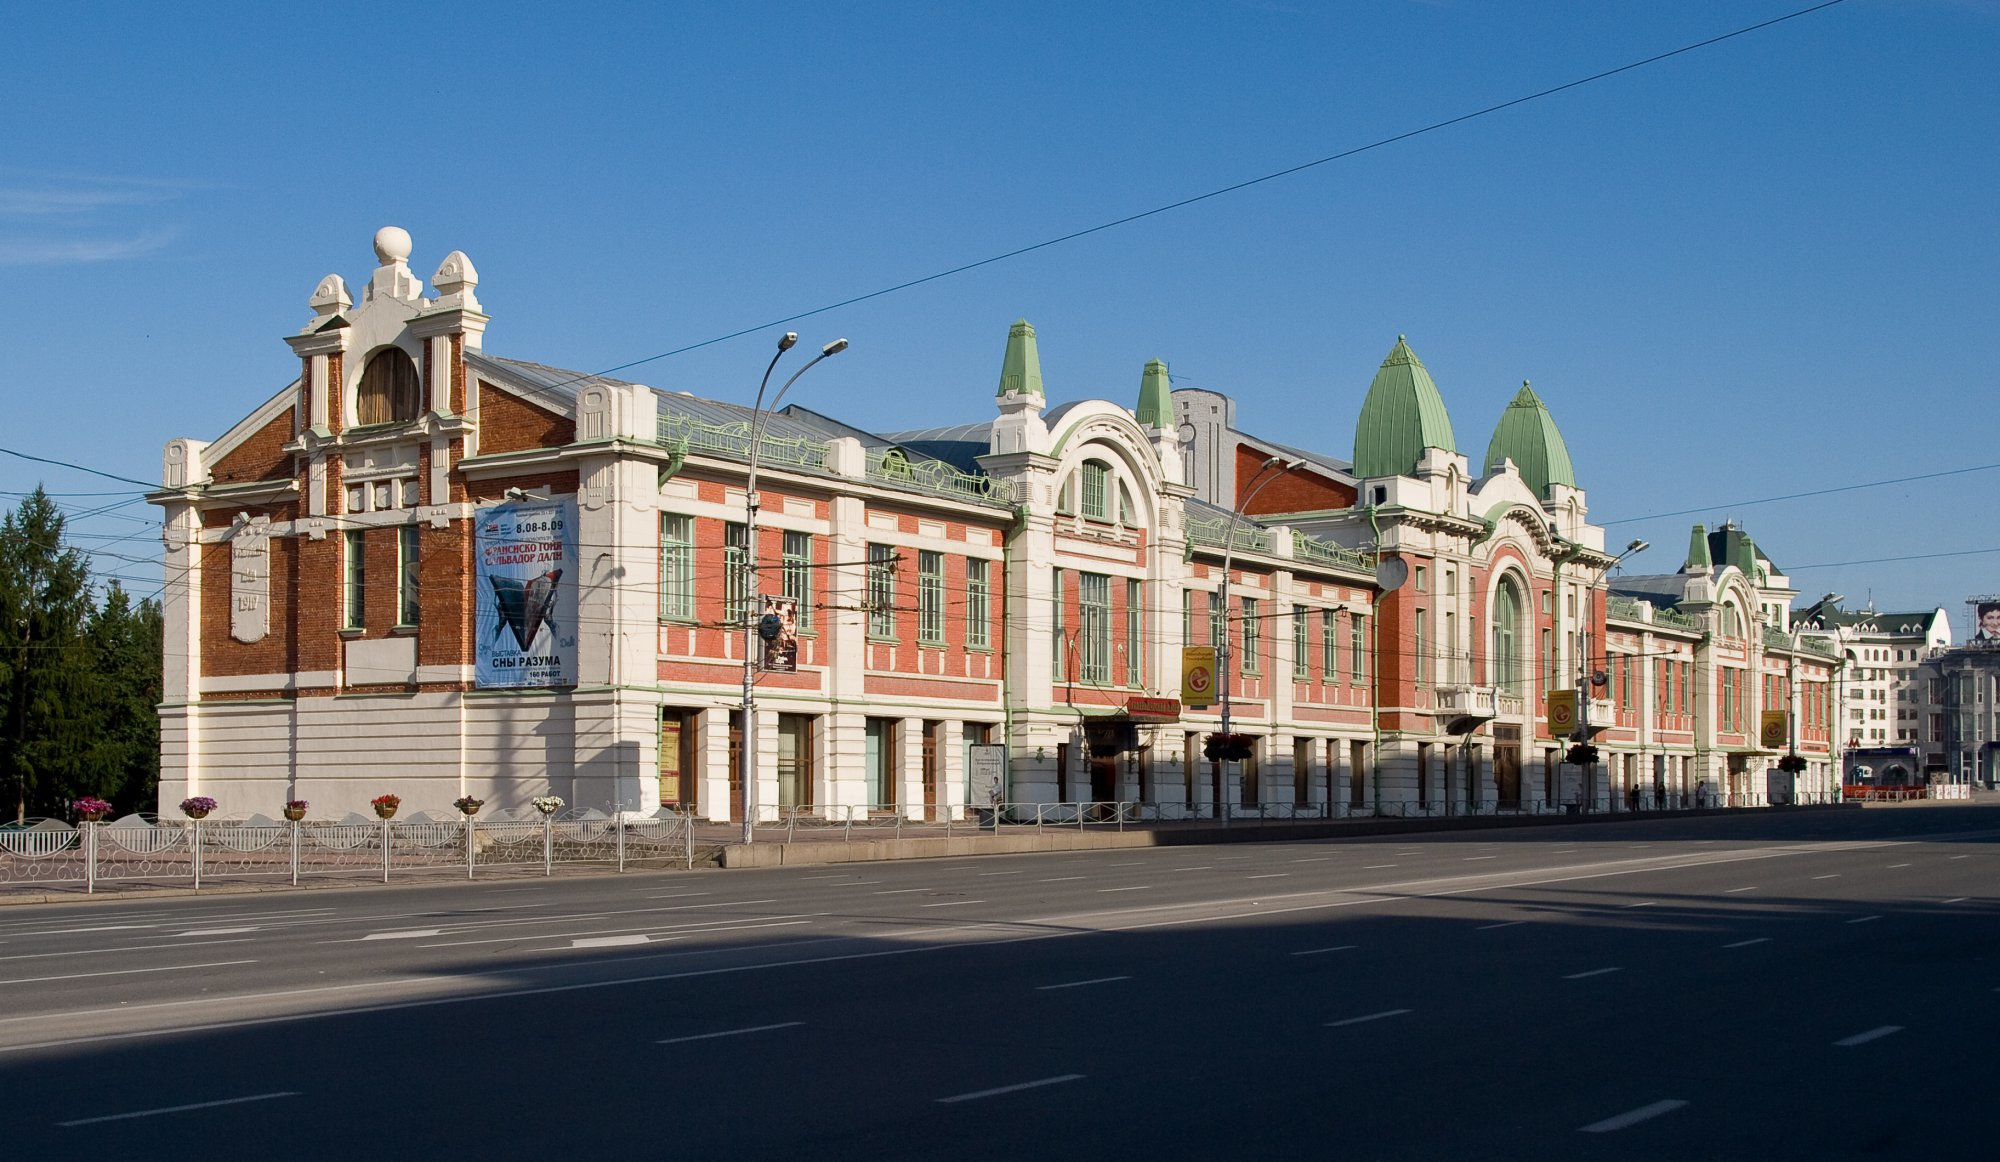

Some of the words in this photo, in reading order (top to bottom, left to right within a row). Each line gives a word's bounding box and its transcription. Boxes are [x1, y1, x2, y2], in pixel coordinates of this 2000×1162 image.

[516, 520, 563, 534] 8.08-8.09
[492, 650, 522, 658] ВЫСТАВКА
[492, 658, 516, 668] СНЫ
[519, 656, 561, 667] РАЗУМА
